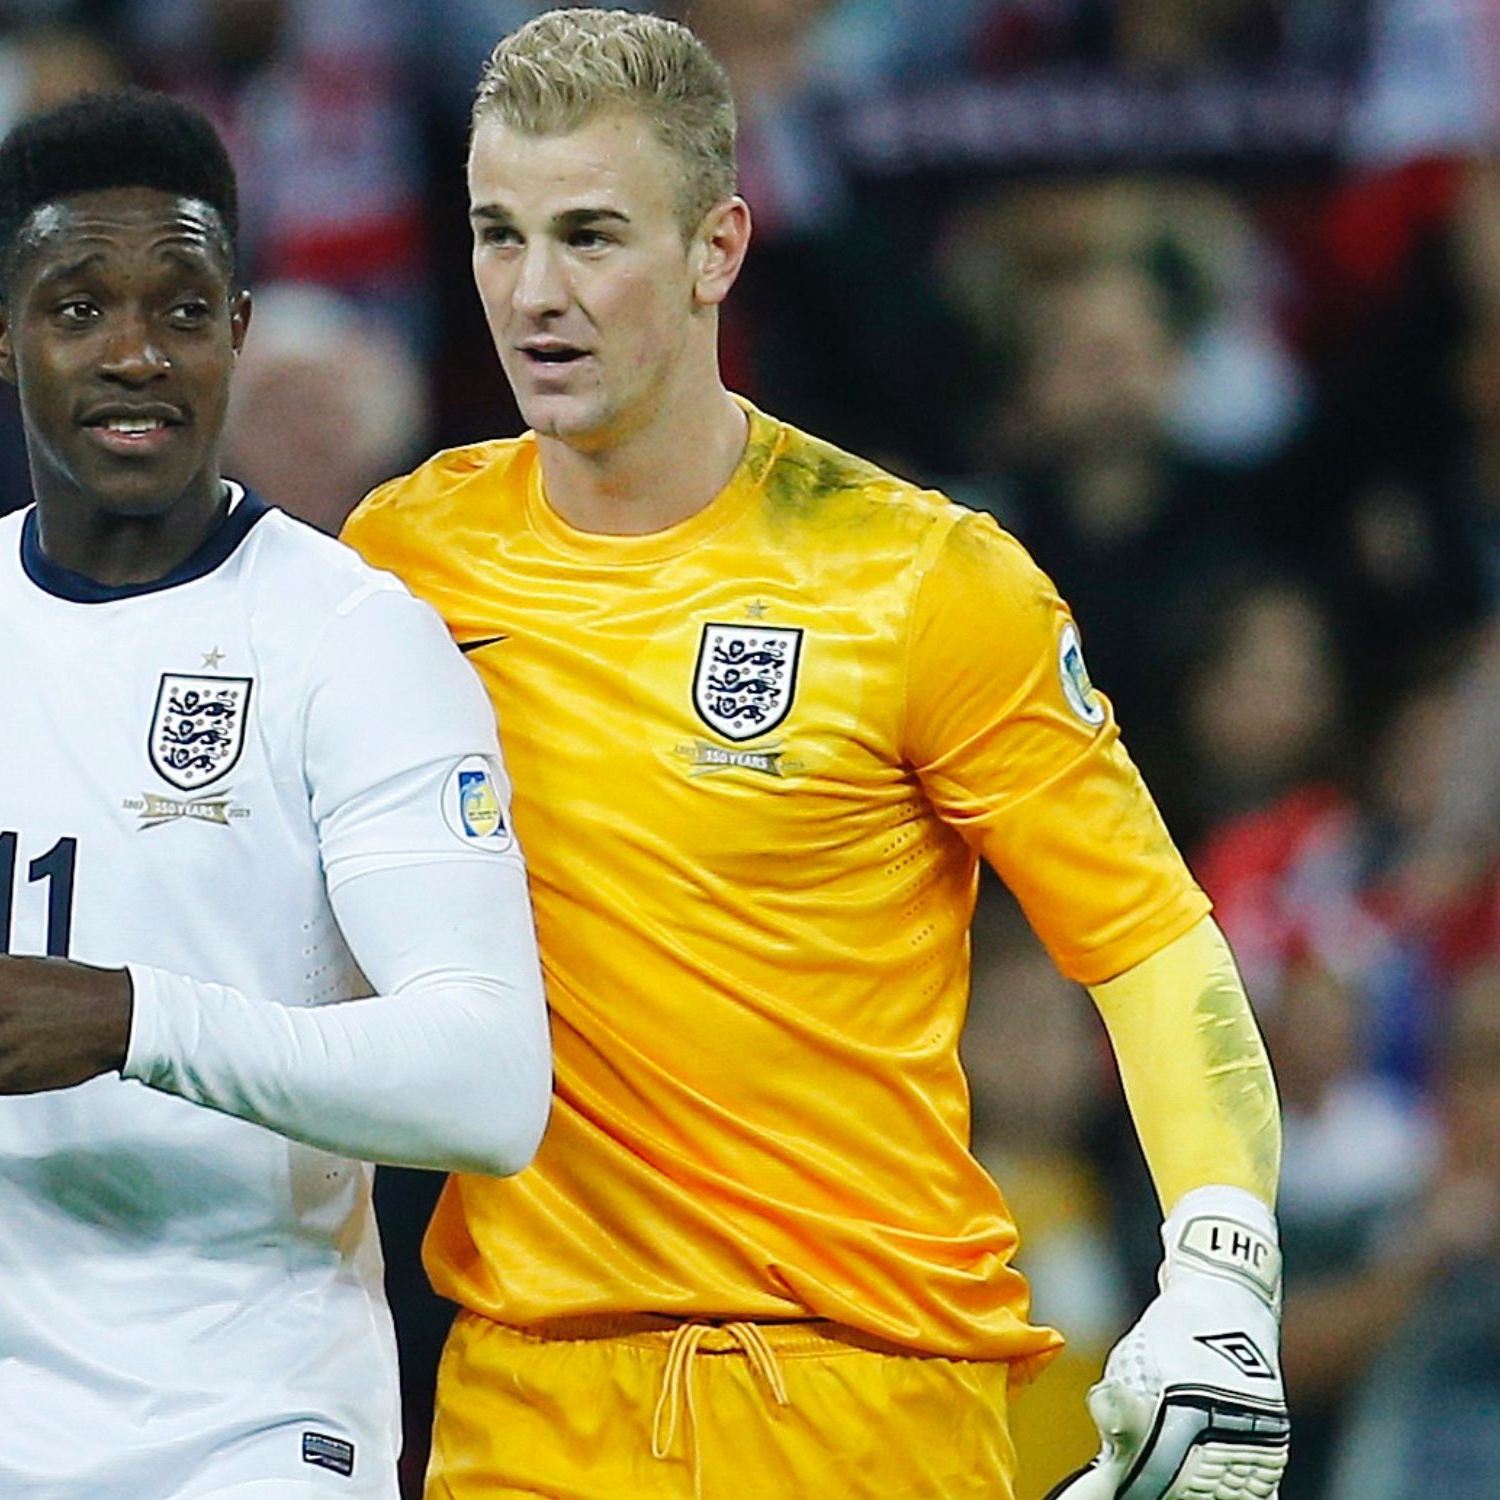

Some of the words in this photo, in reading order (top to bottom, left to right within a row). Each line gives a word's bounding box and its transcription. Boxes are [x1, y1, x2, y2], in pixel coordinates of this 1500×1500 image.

[706, 749, 727, 764] 150
[729, 753, 768, 769] YEARS
[177, 803, 214, 816] YEARS
[1211, 1227, 1268, 1267] JH1
